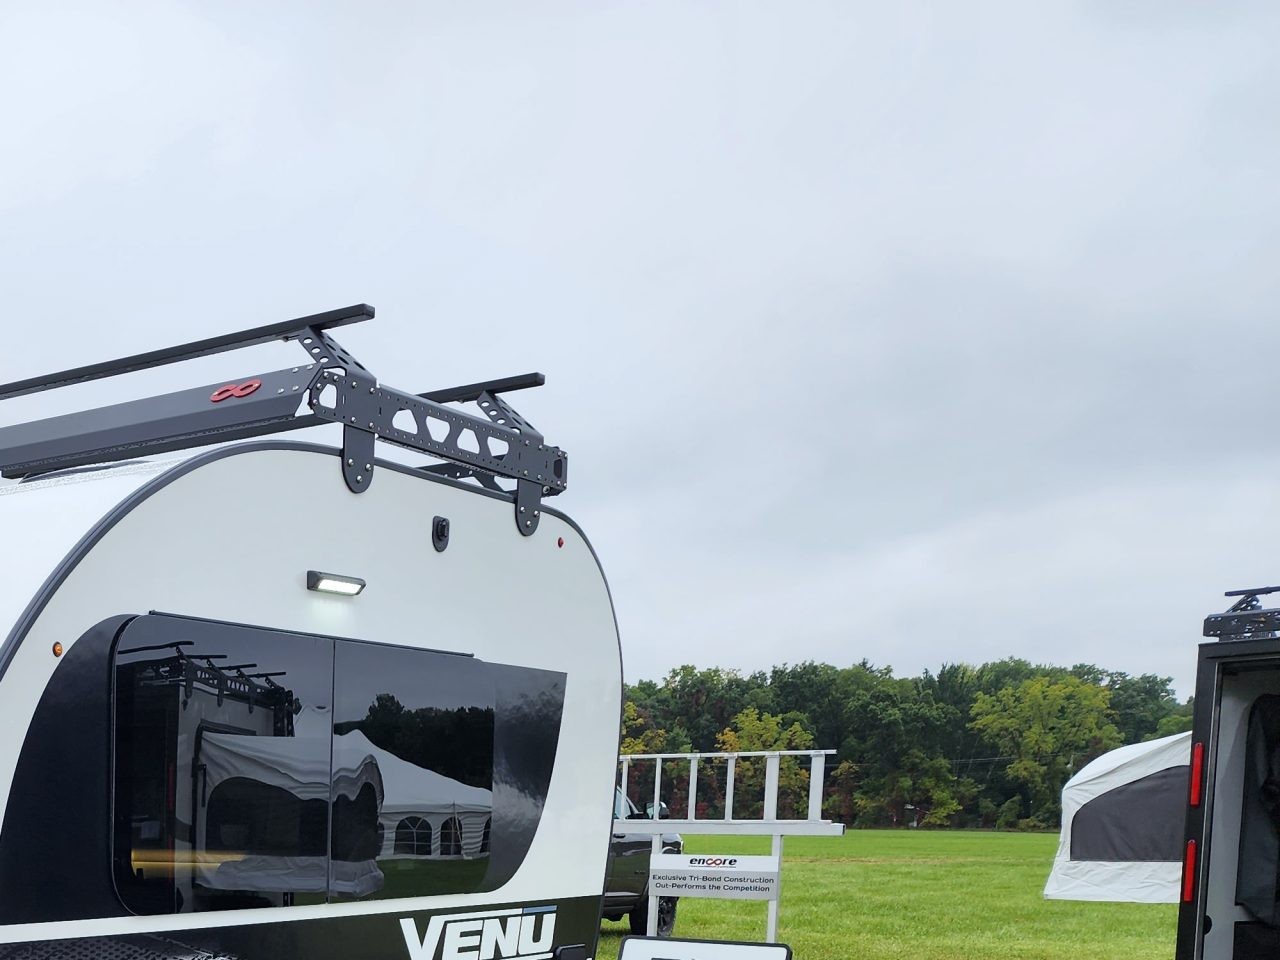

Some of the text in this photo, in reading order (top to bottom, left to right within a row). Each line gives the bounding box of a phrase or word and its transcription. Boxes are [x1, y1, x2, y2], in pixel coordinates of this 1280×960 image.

[690, 857, 738, 866] encore
[652, 874, 775, 884] Exclusive Tri-Bond Construction
[655, 882, 707, 890] Out-Performs
[723, 885, 770, 893] Competition
